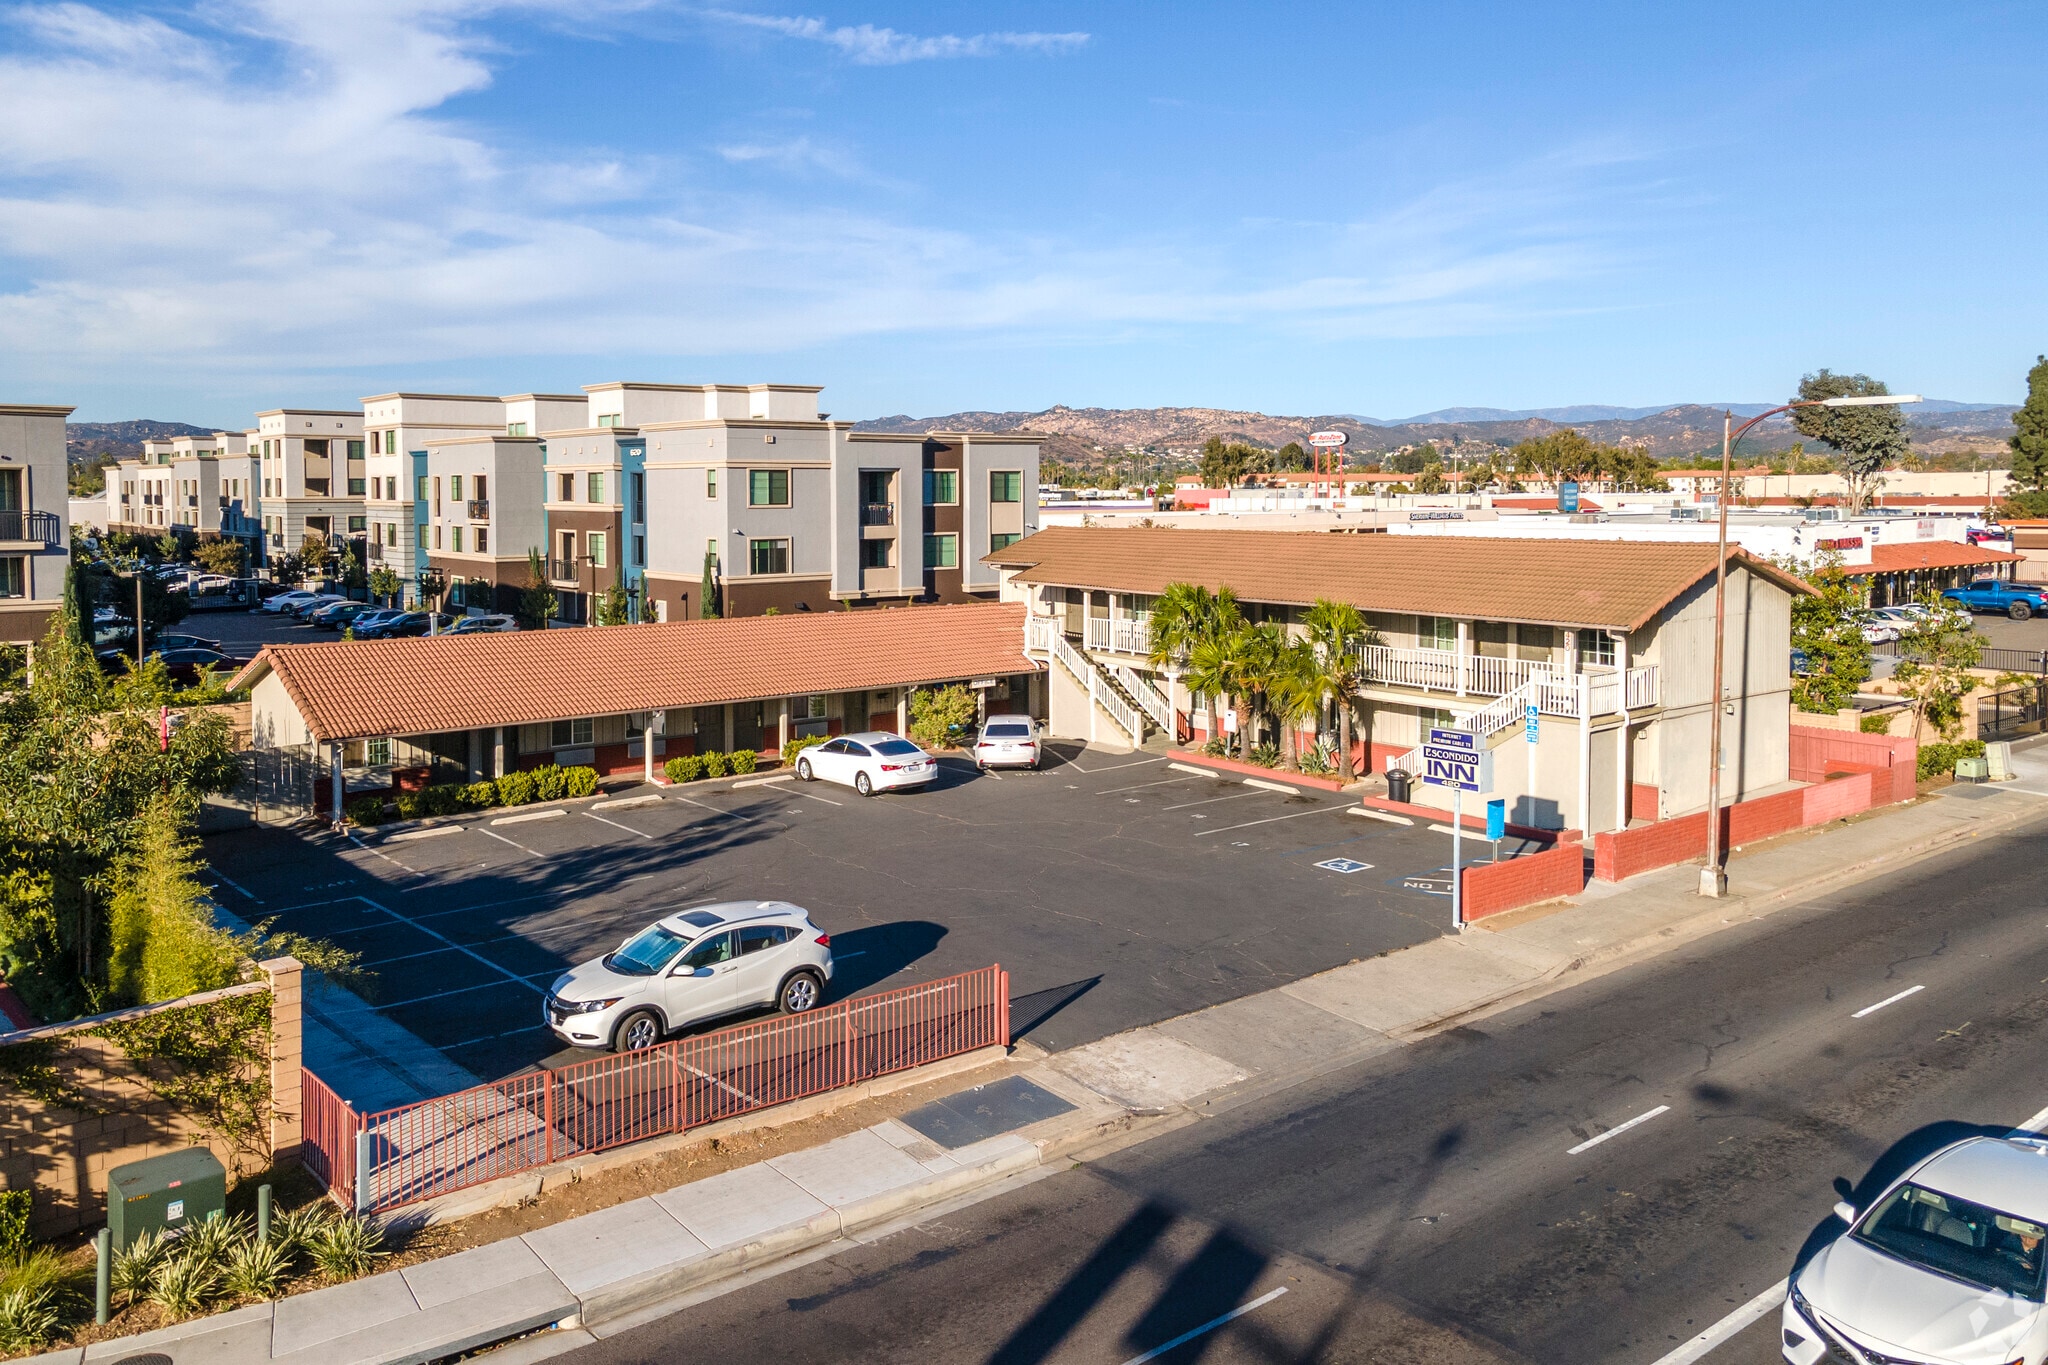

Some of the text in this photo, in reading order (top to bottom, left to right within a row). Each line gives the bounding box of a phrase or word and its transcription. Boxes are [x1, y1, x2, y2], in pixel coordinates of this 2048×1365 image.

[1441, 732, 1462, 740] INTERNET
[1432, 737, 1451, 745] PREMIUM
[1424, 747, 1478, 764] ESCONDIDO
[1427, 759, 1475, 783] INN
[1441, 779, 1461, 788] 420
[1403, 881, 1433, 889] NO
